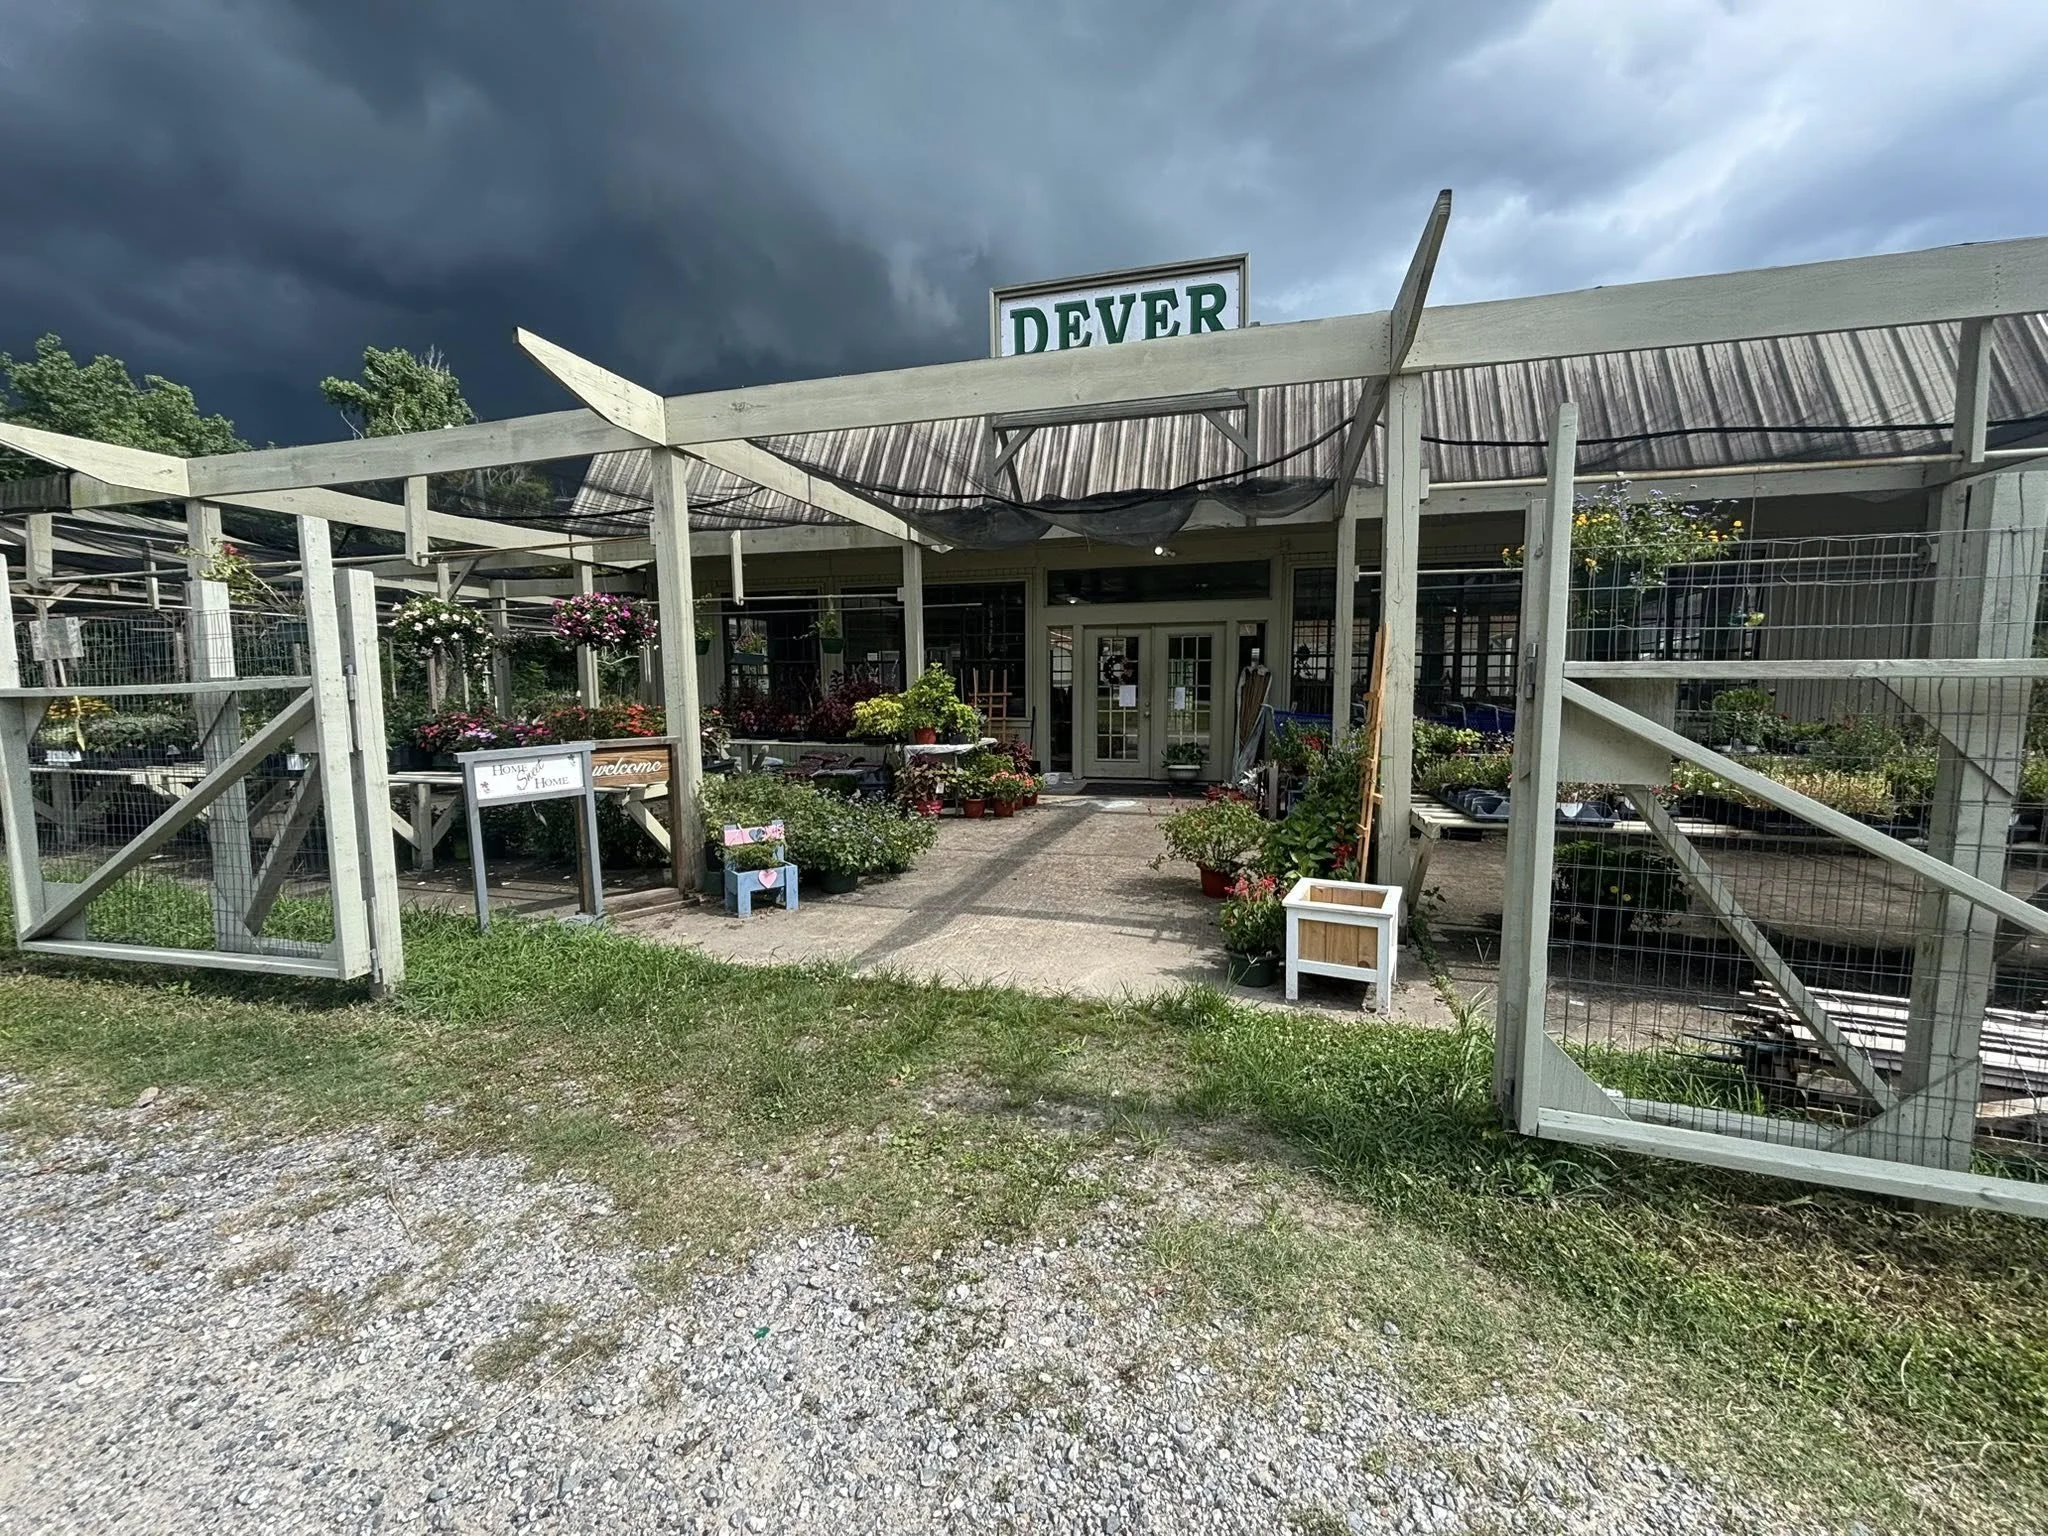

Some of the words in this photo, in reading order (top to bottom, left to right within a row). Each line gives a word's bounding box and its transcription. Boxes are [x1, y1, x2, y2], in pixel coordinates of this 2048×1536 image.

[1009, 282, 1228, 355] DEVER
[492, 764, 528, 777] HOME
[517, 758, 544, 790] Sweet
[592, 757, 662, 777] welcome
[535, 776, 569, 789] HOME
